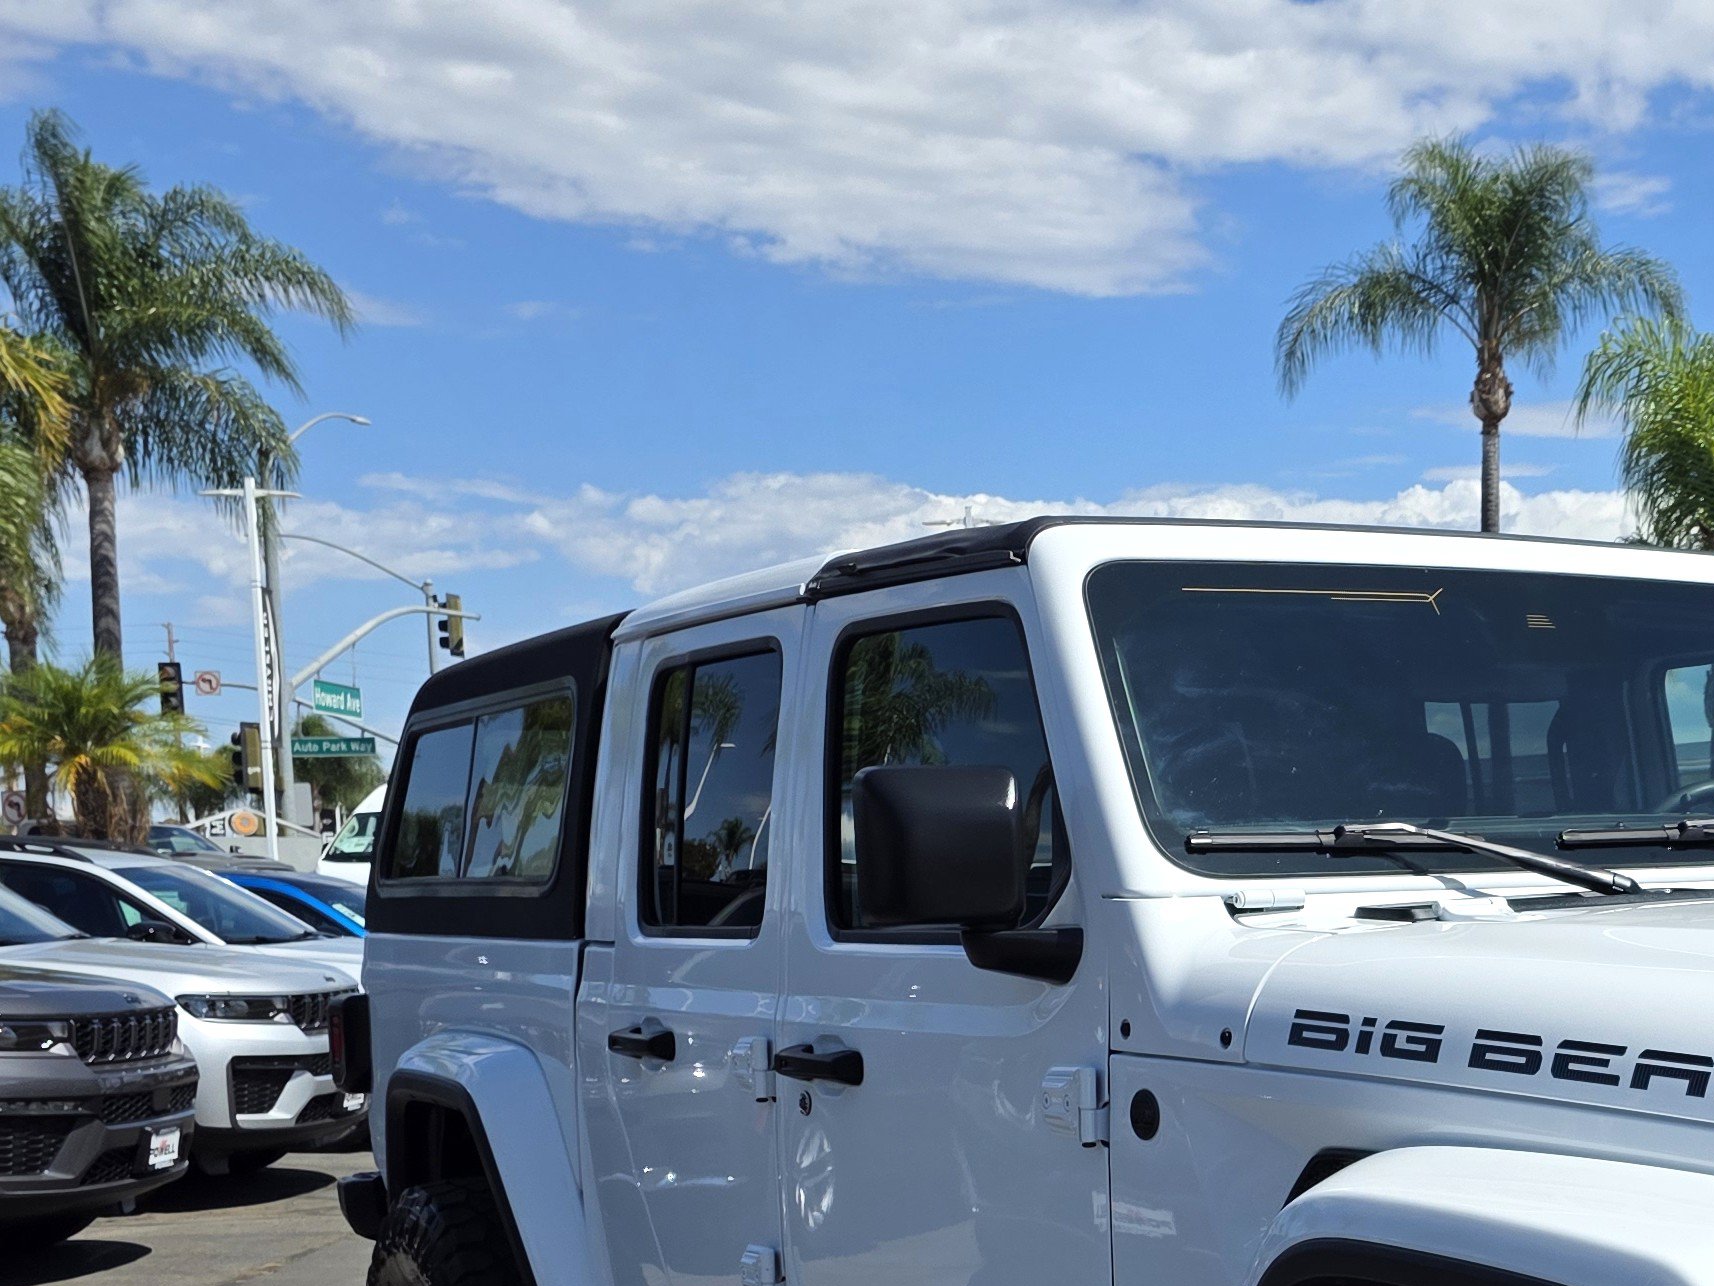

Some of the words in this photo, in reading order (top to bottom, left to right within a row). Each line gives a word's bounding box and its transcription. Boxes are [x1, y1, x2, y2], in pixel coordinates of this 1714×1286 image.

[315, 687, 345, 710] Howard
[346, 691, 361, 713] Ave
[293, 741, 319, 753] Auto
[322, 741, 348, 752] Park
[350, 741, 373, 753] Way
